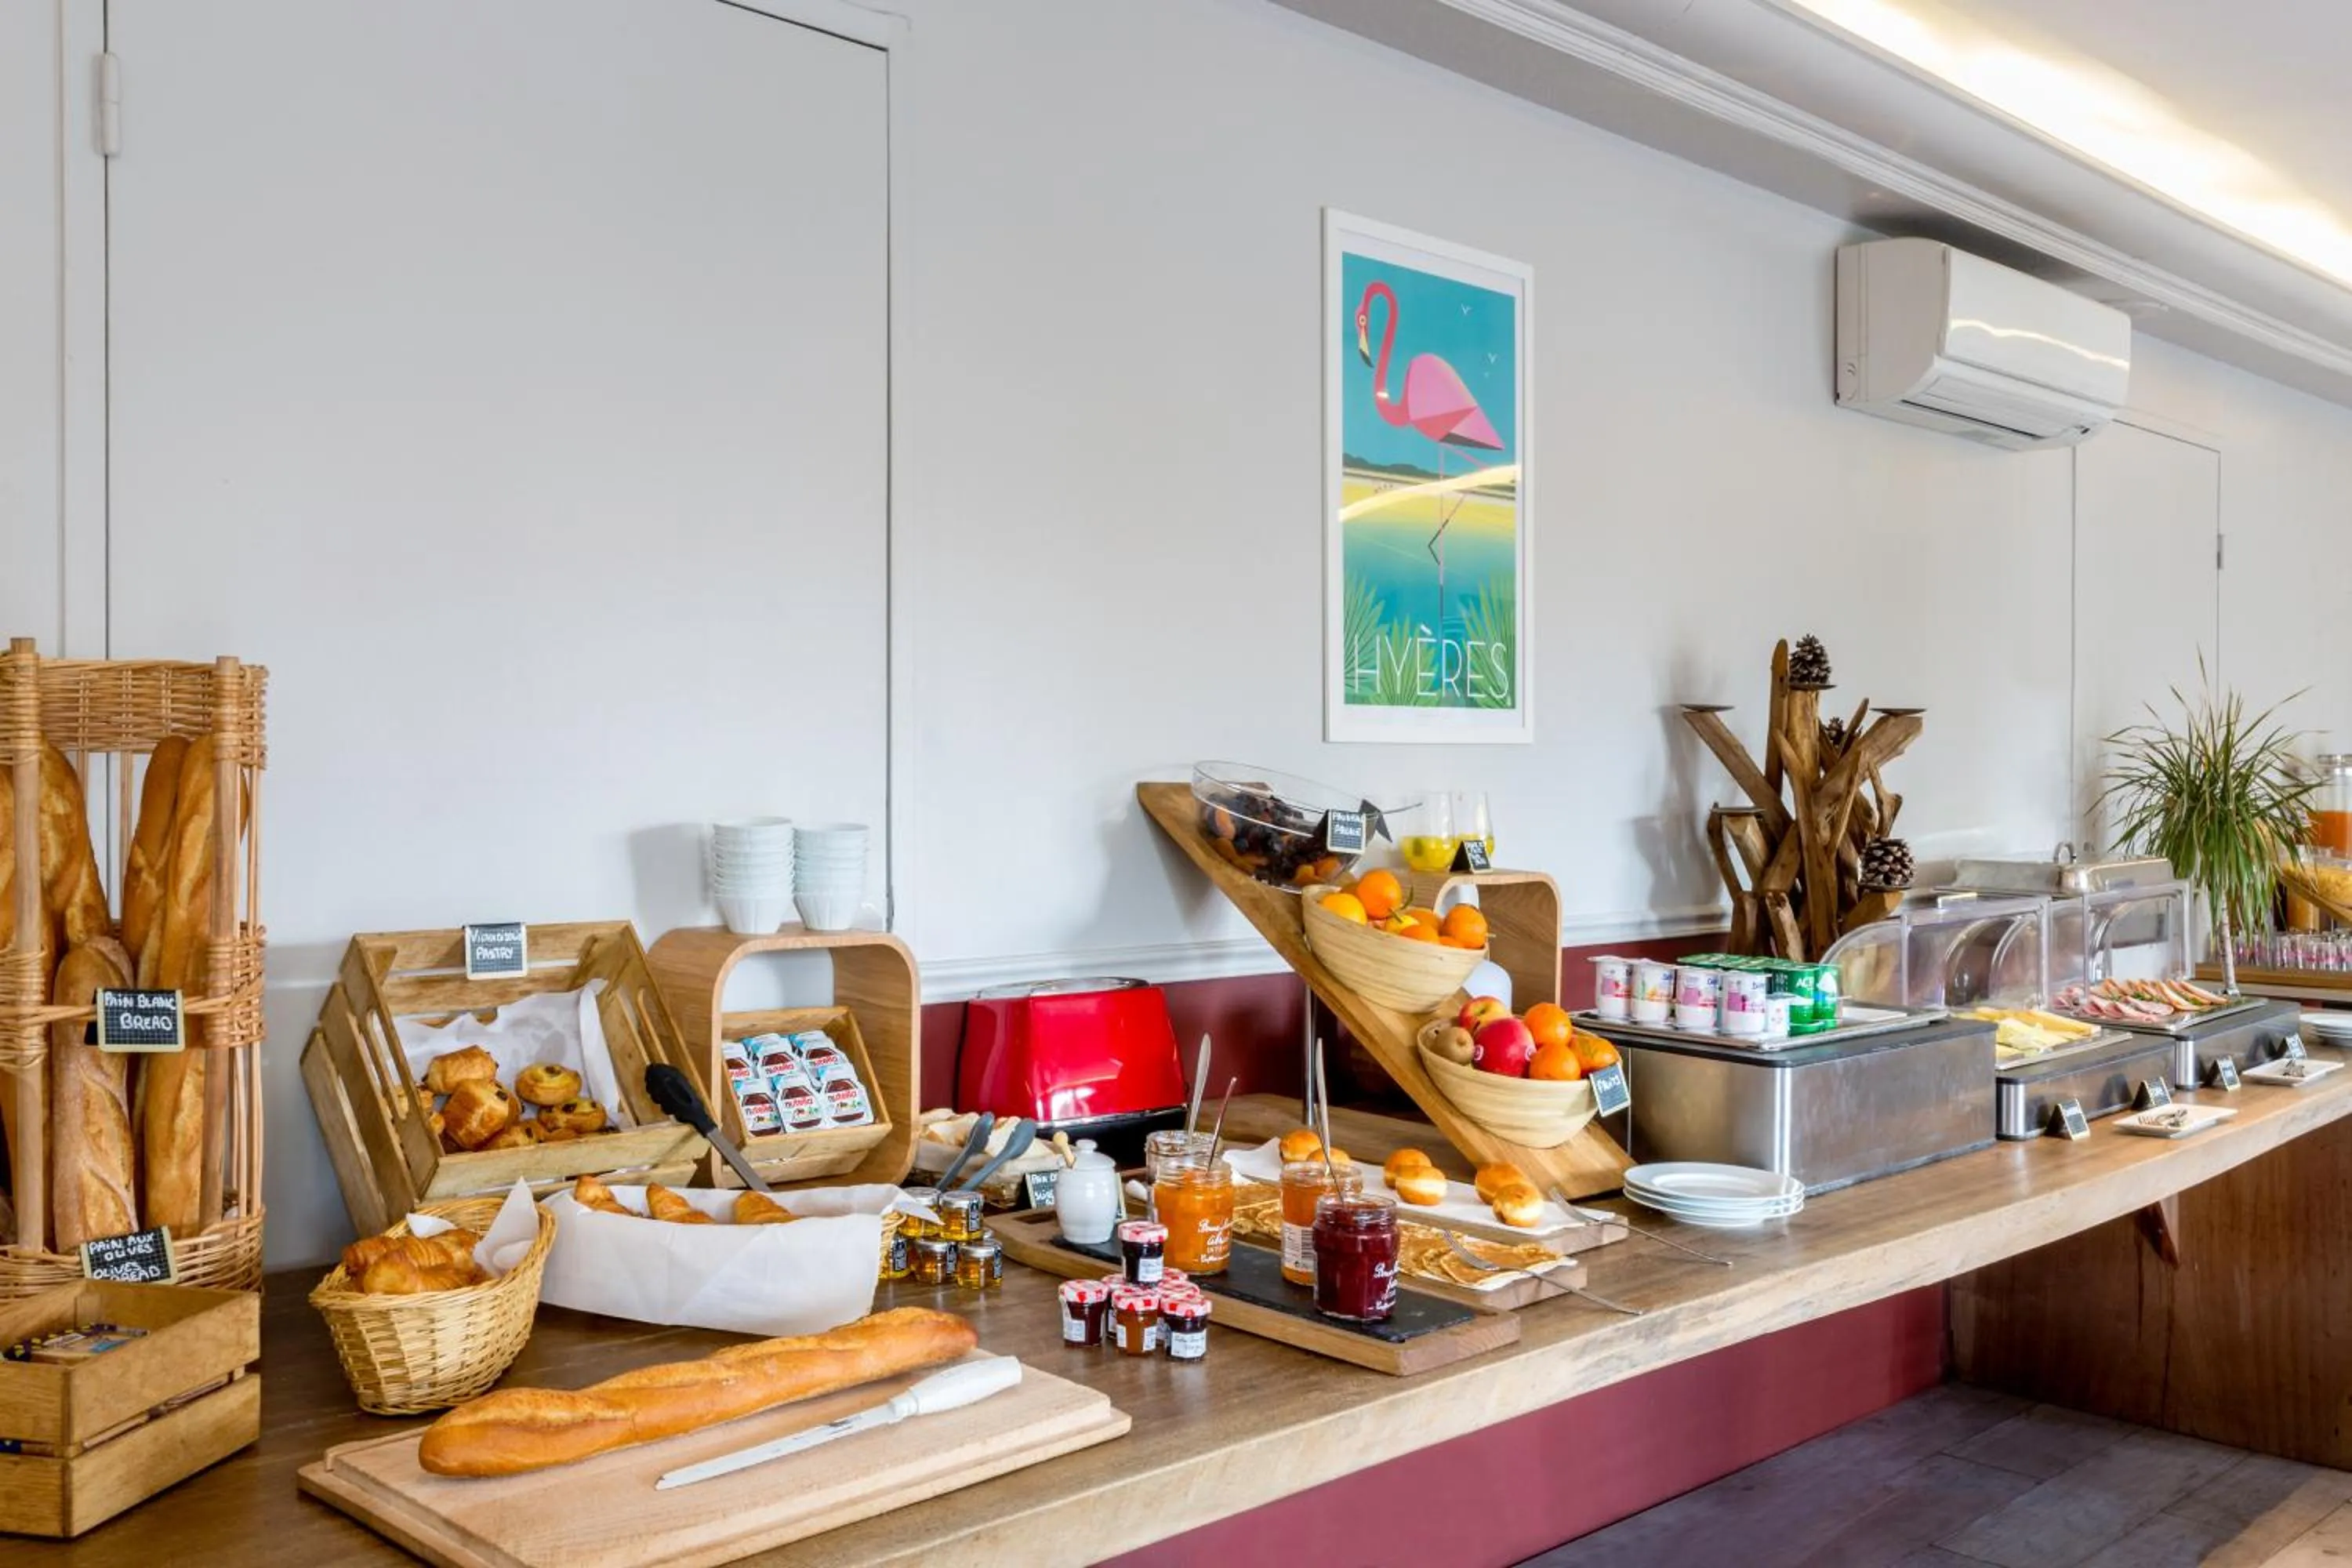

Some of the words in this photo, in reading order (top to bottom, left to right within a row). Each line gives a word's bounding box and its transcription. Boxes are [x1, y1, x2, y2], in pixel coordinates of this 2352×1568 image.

[1354, 624, 1509, 699] HYÈRES
[476, 946, 514, 960] PASTRY
[137, 993, 177, 1011] BLANC
[128, 1232, 154, 1246] AUX
